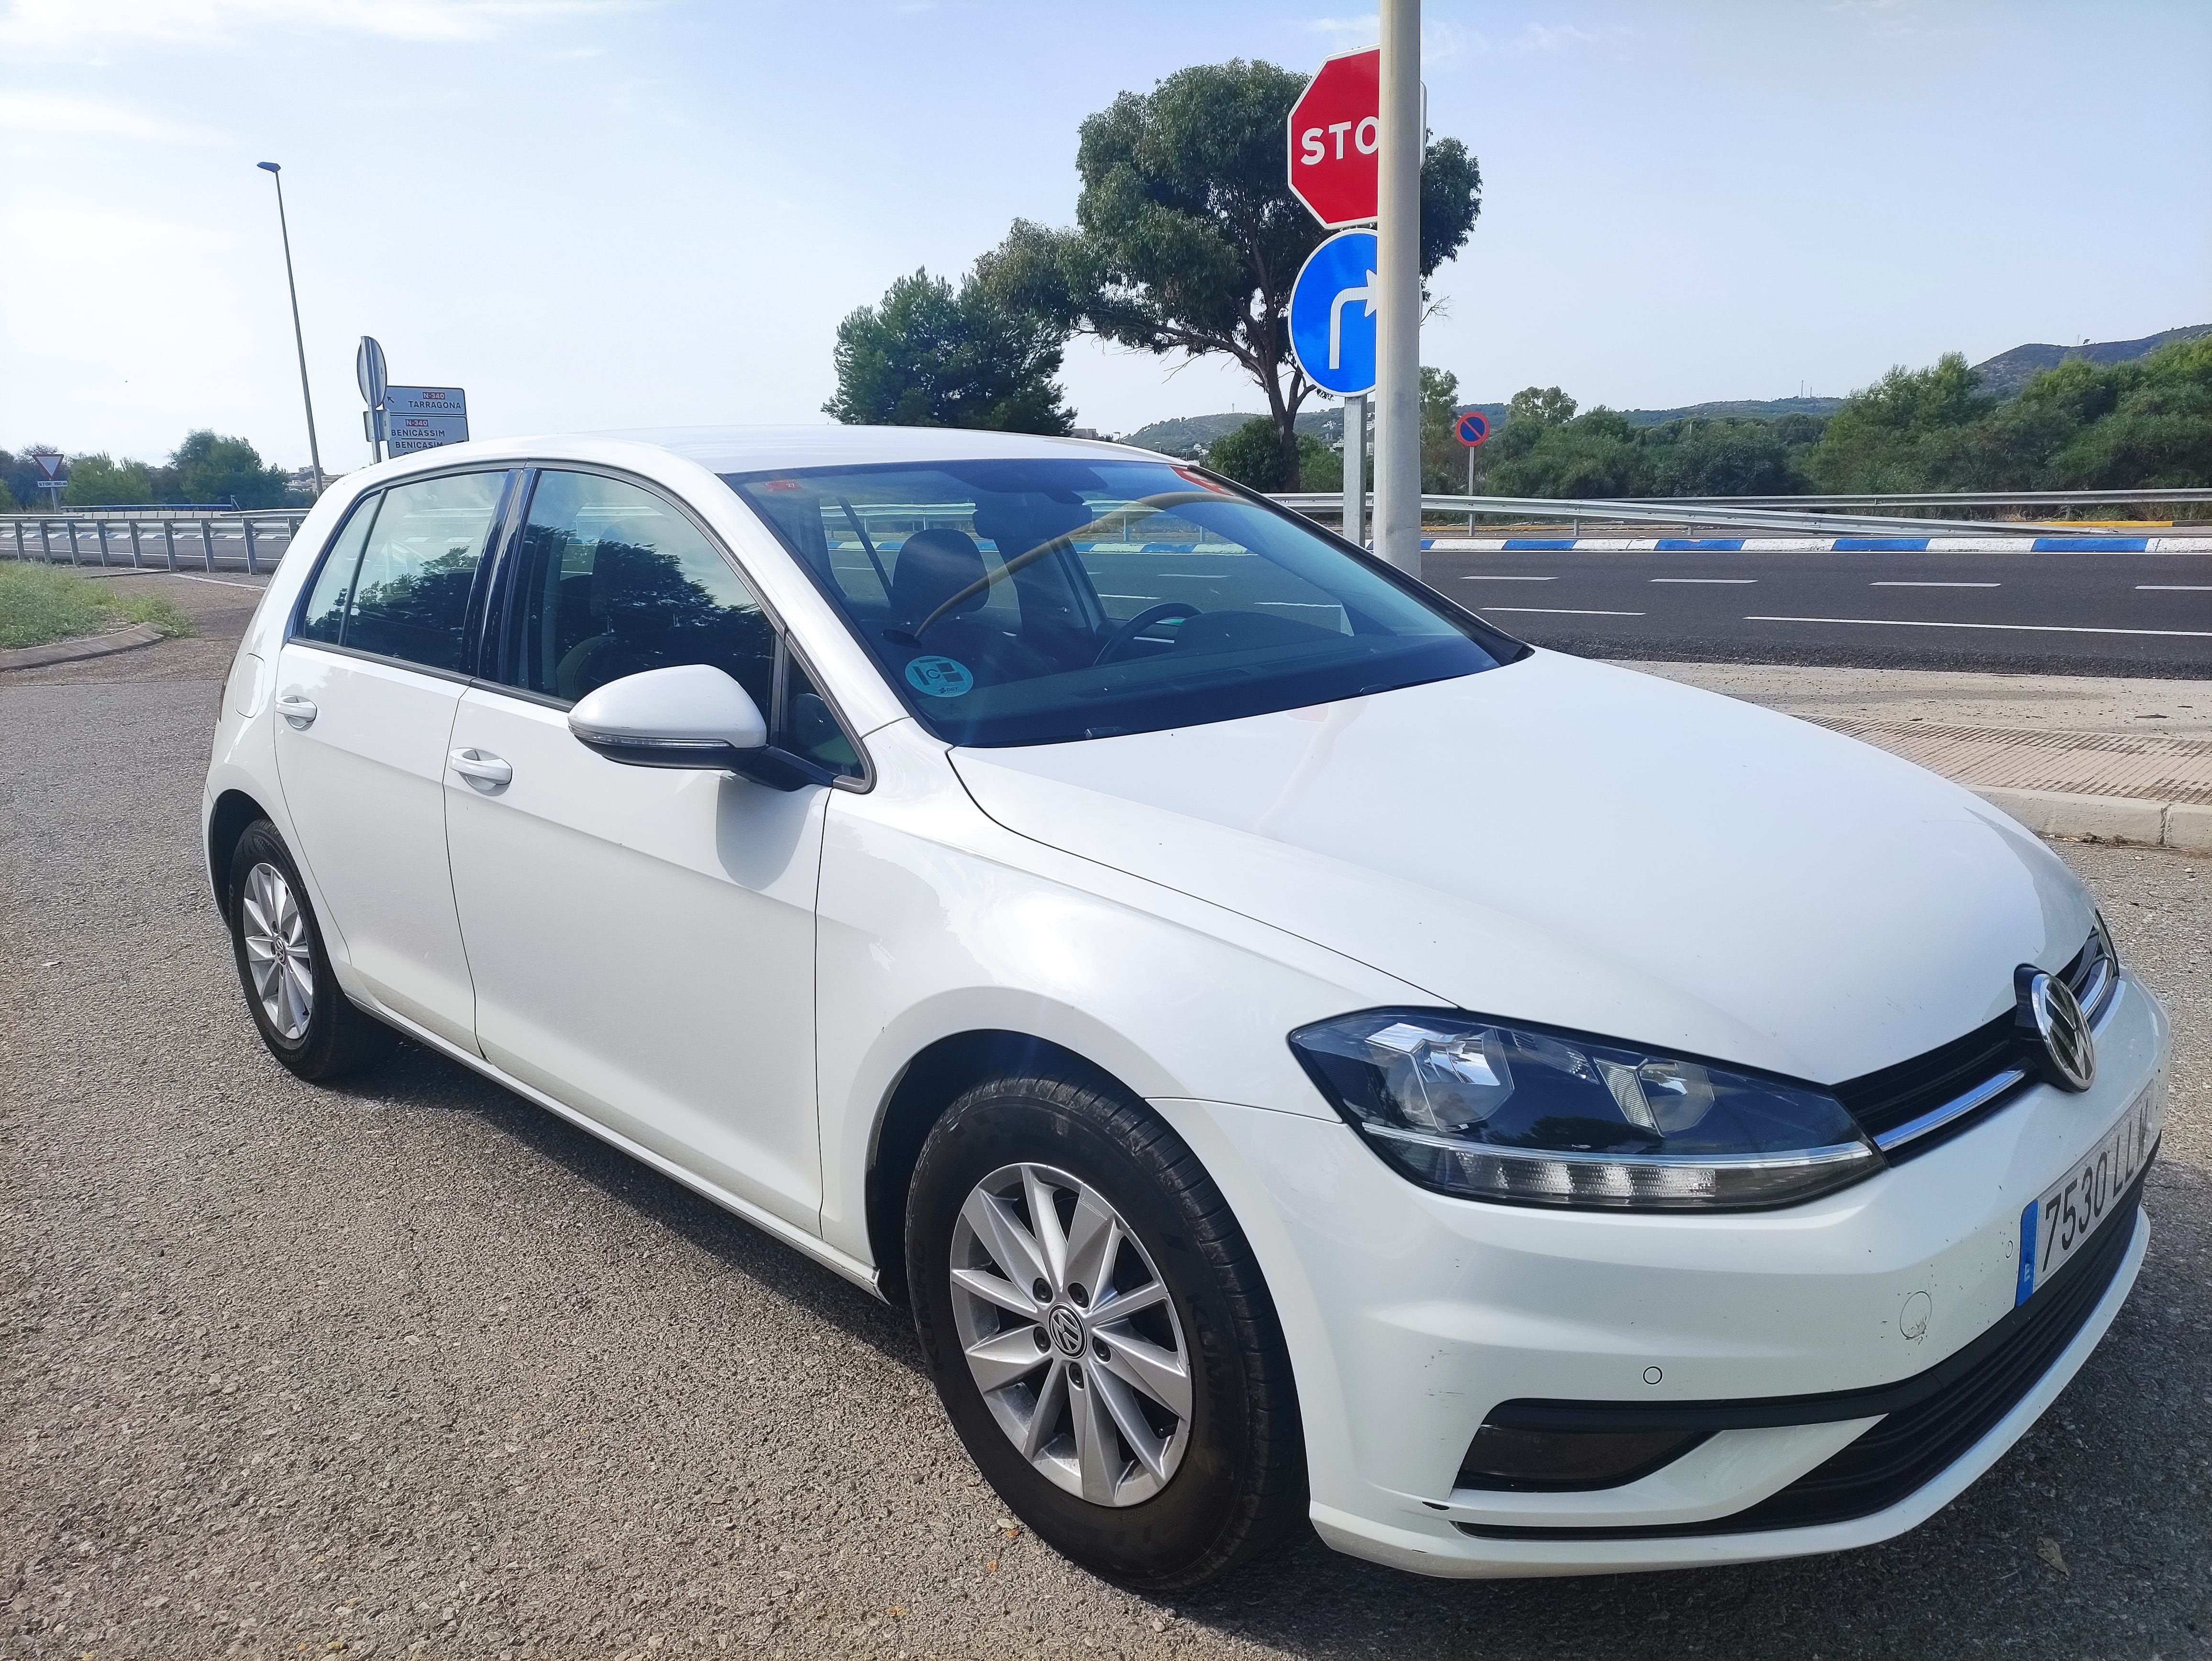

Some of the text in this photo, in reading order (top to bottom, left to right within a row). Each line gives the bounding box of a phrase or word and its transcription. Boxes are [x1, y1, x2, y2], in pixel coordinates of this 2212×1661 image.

[1300, 116, 1380, 165] STO
[409, 400, 461, 409] TARRAGONA
[391, 428, 445, 436] BENICÀSSIM
[926, 669, 940, 679] C
[2042, 1151, 2108, 1273] 7530
[2024, 1263, 2031, 1282] E
